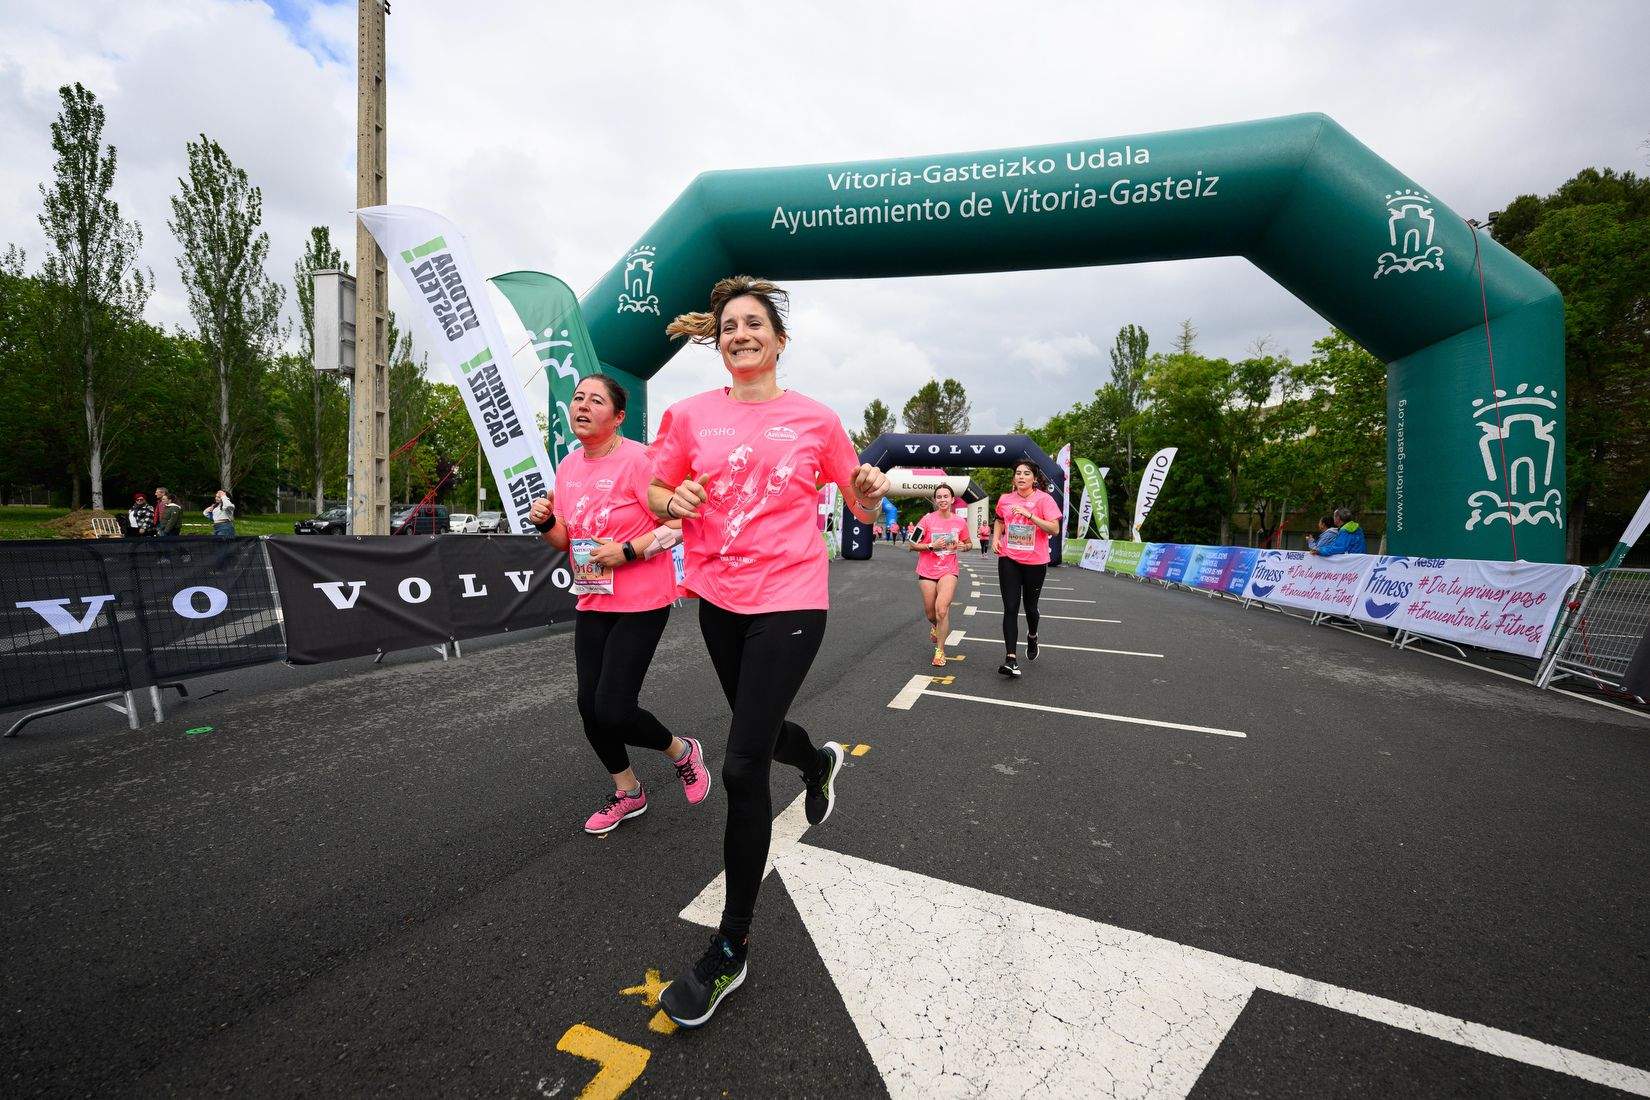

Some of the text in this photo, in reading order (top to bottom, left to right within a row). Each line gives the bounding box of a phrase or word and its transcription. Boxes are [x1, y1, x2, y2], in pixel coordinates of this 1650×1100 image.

[827, 144, 1151, 191] Vitoria-Gasteizko Udala
[770, 169, 1220, 235] Ayuntamiento de Vitoria-Gasteiz
[699, 427, 736, 437] OYSHO
[905, 444, 1006, 455] VOLVO
[1396, 399, 1407, 532] www.vitoria-gasteiz.org
[902, 482, 911, 490] EL
[1141, 455, 1169, 518] AMUTIO
[1252, 560, 1284, 583] Fitness
[1287, 564, 1304, 579] #Da
[1304, 566, 1315, 579] tu
[1310, 569, 1339, 585] primer
[1364, 567, 1413, 599] Fitness
[313, 567, 571, 610] VOLVO
[1280, 583, 1321, 599] #Encuentra
[1321, 587, 1332, 602] tu
[1418, 575, 1547, 612] #Da tu primer paso
[1407, 601, 1475, 627] #Encuentra
[1474, 611, 1492, 631] tu
